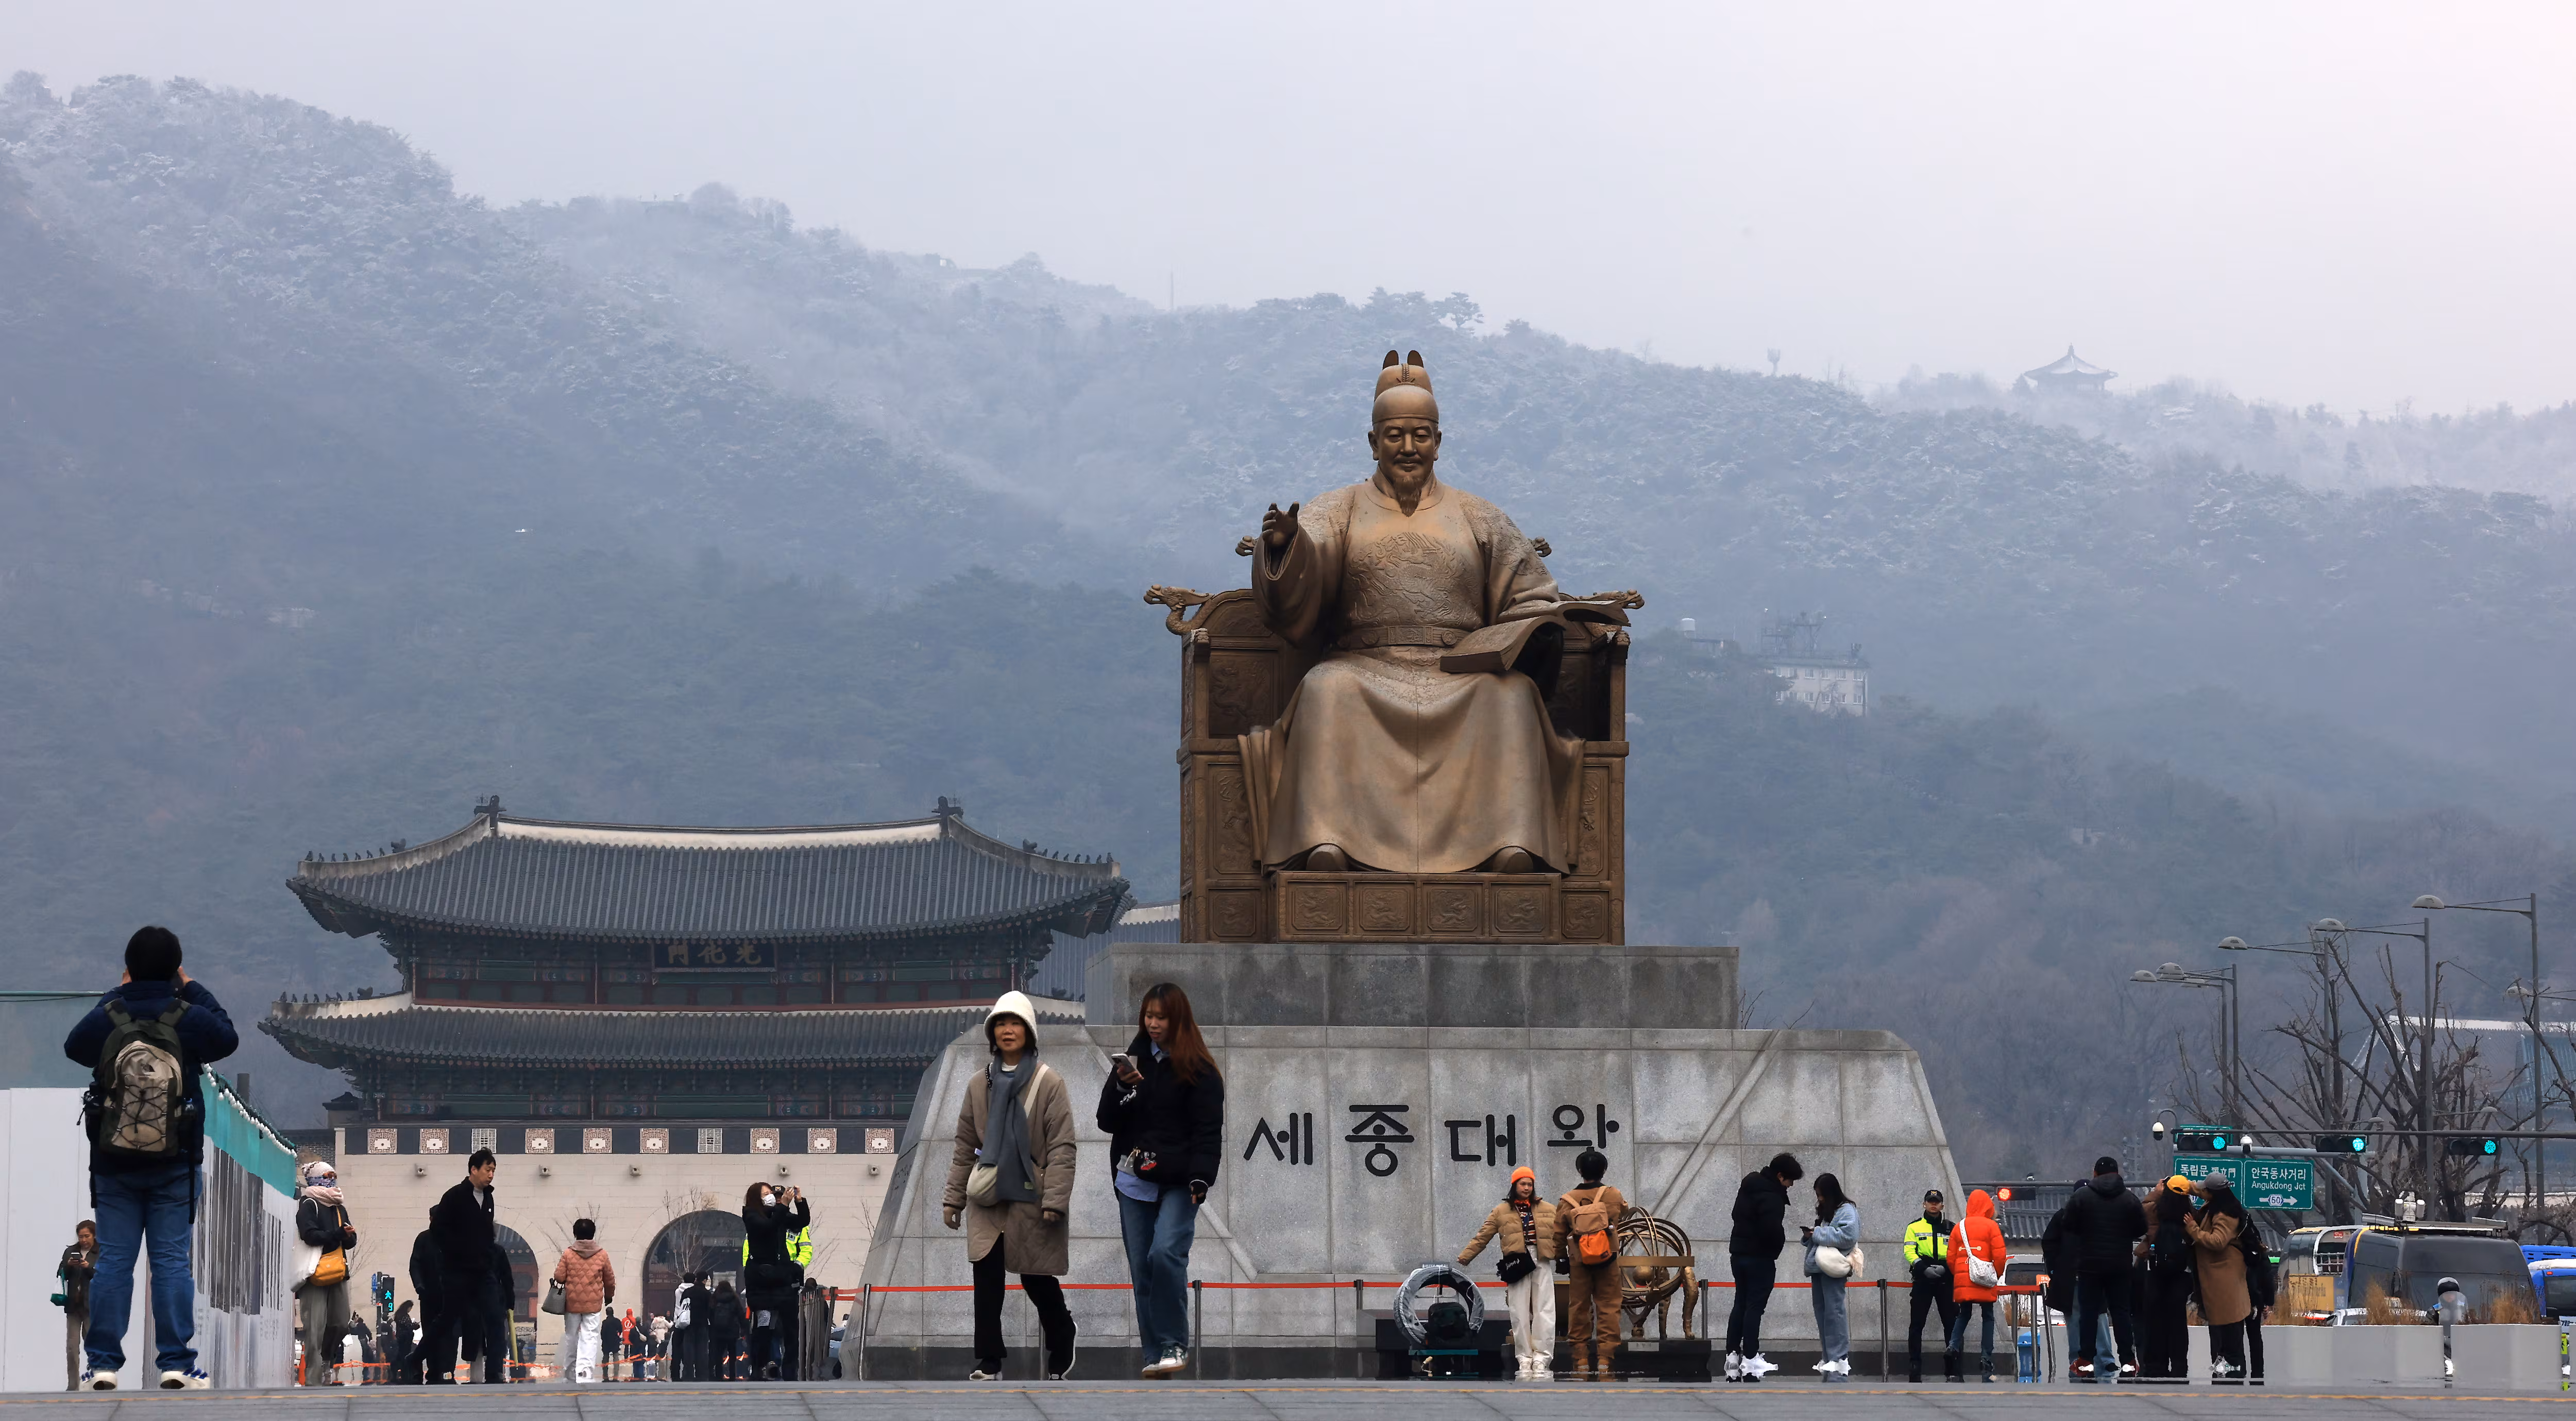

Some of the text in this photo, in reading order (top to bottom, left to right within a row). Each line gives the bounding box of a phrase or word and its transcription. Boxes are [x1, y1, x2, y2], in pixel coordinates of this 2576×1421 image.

[1243, 1104, 1619, 1177] 세종대왕
[2180, 1164, 2208, 1177] 독립문
[2251, 1167, 2306, 1180] 안국동사거리
[2251, 1180, 2306, 1192] Angukdong Jct
[388, 1302, 393, 1311] 9
